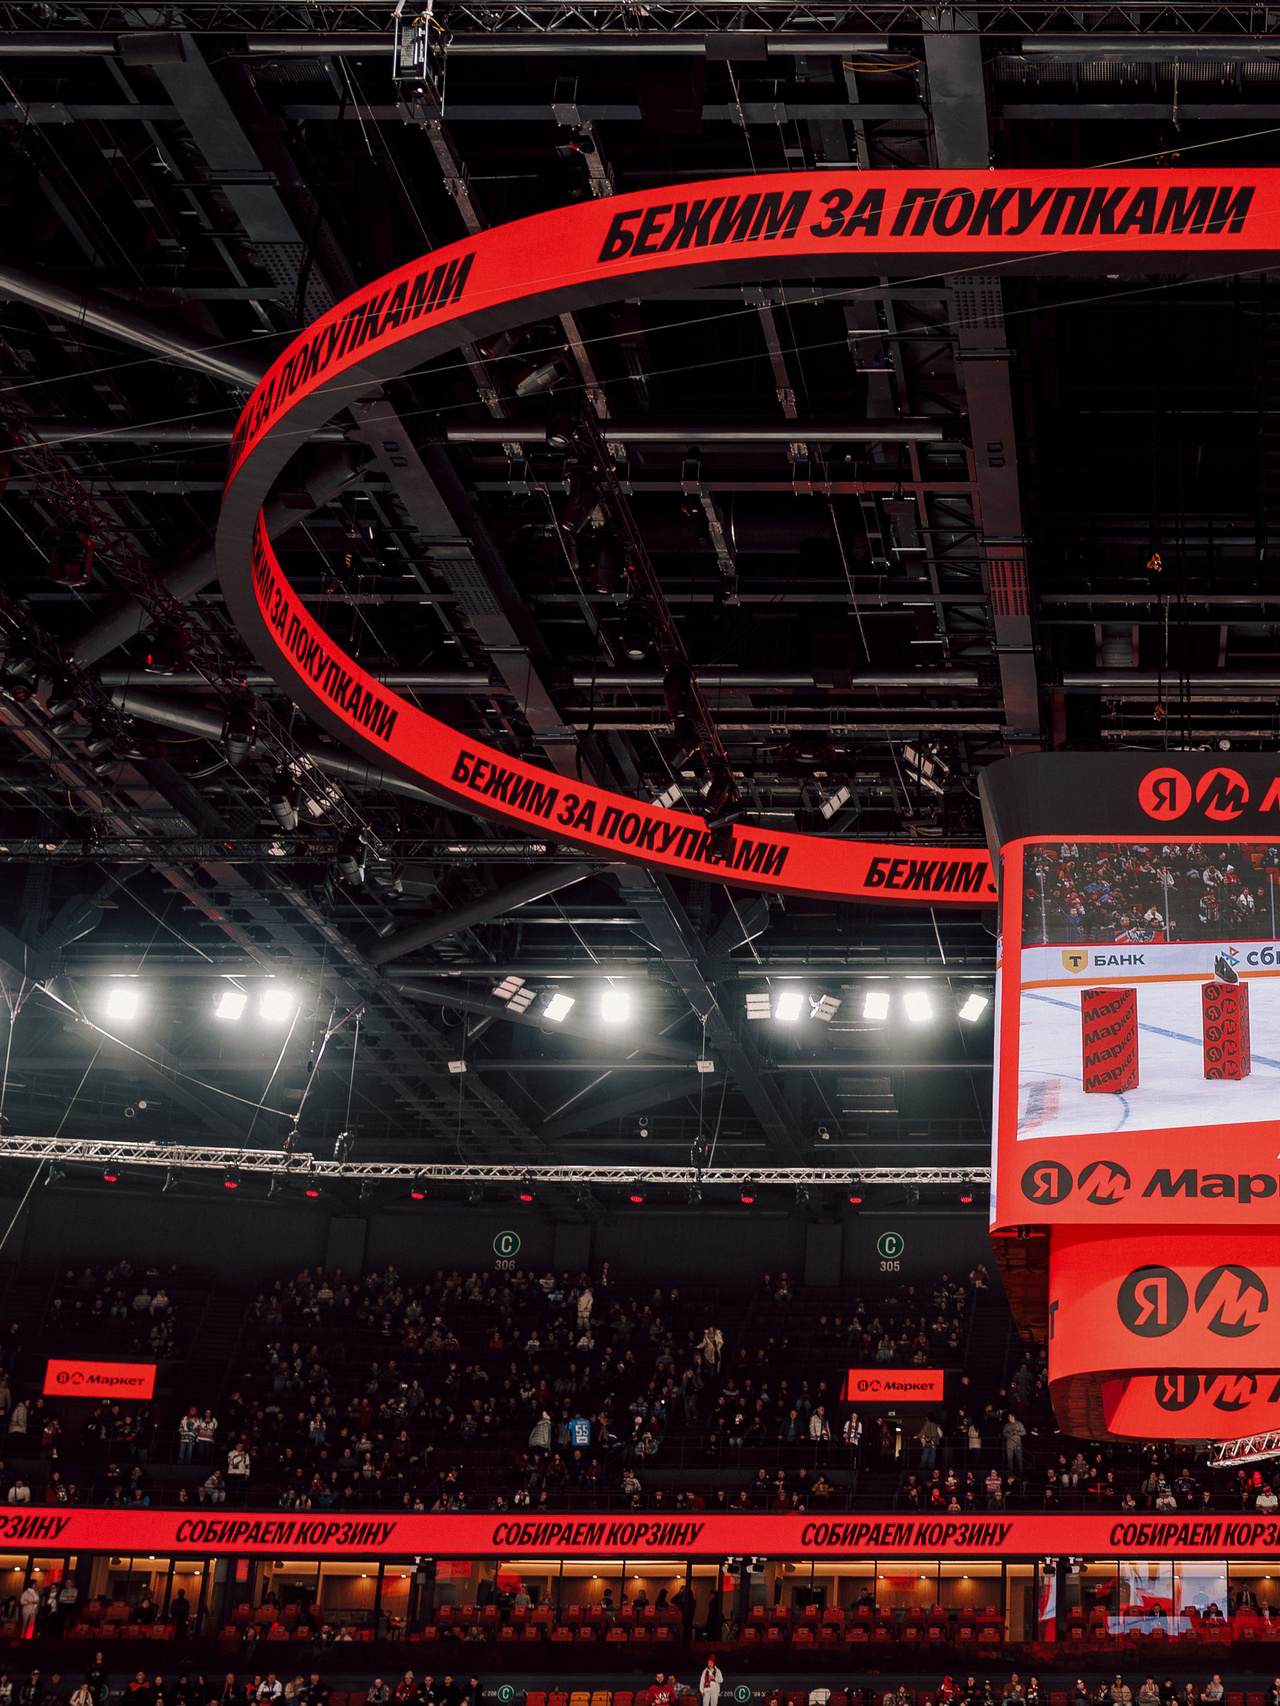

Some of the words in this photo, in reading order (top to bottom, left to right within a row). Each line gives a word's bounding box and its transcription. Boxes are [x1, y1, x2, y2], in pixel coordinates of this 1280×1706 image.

[597, 190, 812, 263] БЕЖИМ
[810, 188, 886, 237] ЗА
[889, 187, 1255, 237] ПОКУПКАМИ
[250, 375, 277, 441] ЗА
[272, 251, 477, 413] ПОКУПКАМИ
[271, 588, 288, 638] ЗА
[286, 612, 398, 742] ПОКУПКАМИ
[452, 750, 560, 819] БЕЖИМ
[557, 793, 597, 832] ЗА
[863, 856, 989, 892] БЕЖИМ
[1094, 954, 1146, 967] БАНК
[1084, 1004, 1135, 1046] Маркет
[1085, 1025, 1135, 1068] Маркет
[1085, 1047, 1136, 1090] Маркет
[494, 1259, 516, 1271] 306
[879, 1260, 901, 1272] 305
[86, 1375, 145, 1386] Маркет
[883, 1381, 935, 1391] Маркет
[575, 1424, 589, 1436] 55
[175, 1520, 297, 1544] СОБИРАЕМ
[294, 1522, 397, 1545] КОРЗИНУ
[492, 1523, 607, 1546] СОБИРАЕМ
[604, 1523, 705, 1546] КОРЗИНУ
[801, 1523, 914, 1546] СОБИРАЕМ
[913, 1523, 1013, 1546] КОРЗИНУ
[1109, 1523, 1223, 1546] СОБИРАЕМ
